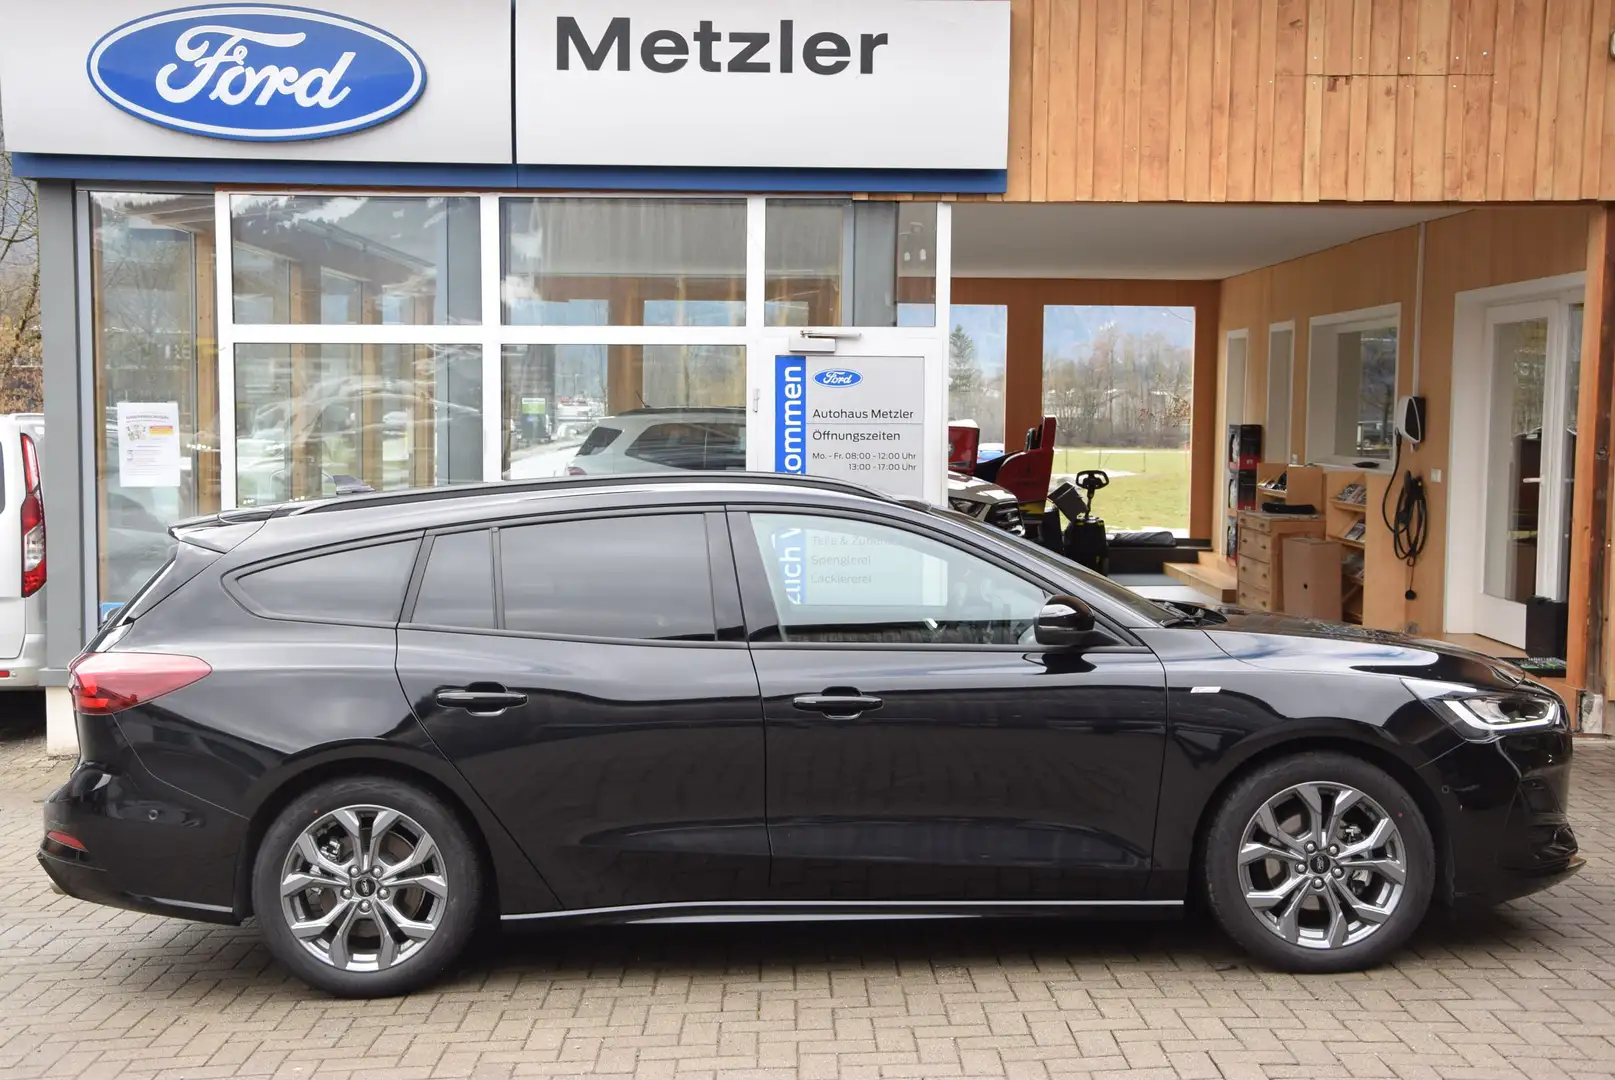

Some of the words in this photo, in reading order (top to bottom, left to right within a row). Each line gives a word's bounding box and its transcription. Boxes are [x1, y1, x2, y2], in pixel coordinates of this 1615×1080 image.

[556, 16, 889, 76] Metzler
[155, 25, 356, 109] Ford
[822, 371, 853, 384] Ford
[812, 409, 869, 419] Autohaus
[870, 409, 914, 419] Metzler
[812, 430, 901, 442] Öffnungszeiten
[812, 452, 827, 460] Mo.
[833, 452, 844, 460] Fr.
[845, 452, 871, 460] 08:00
[878, 452, 900, 460] 12:00
[901, 452, 916, 460] Uhr
[848, 463, 871, 471] 13:00
[878, 463, 900, 471] 17:00
[901, 463, 916, 471] Uhr
[811, 555, 872, 567] Spenglerei
[811, 574, 872, 584] Lackiererei
